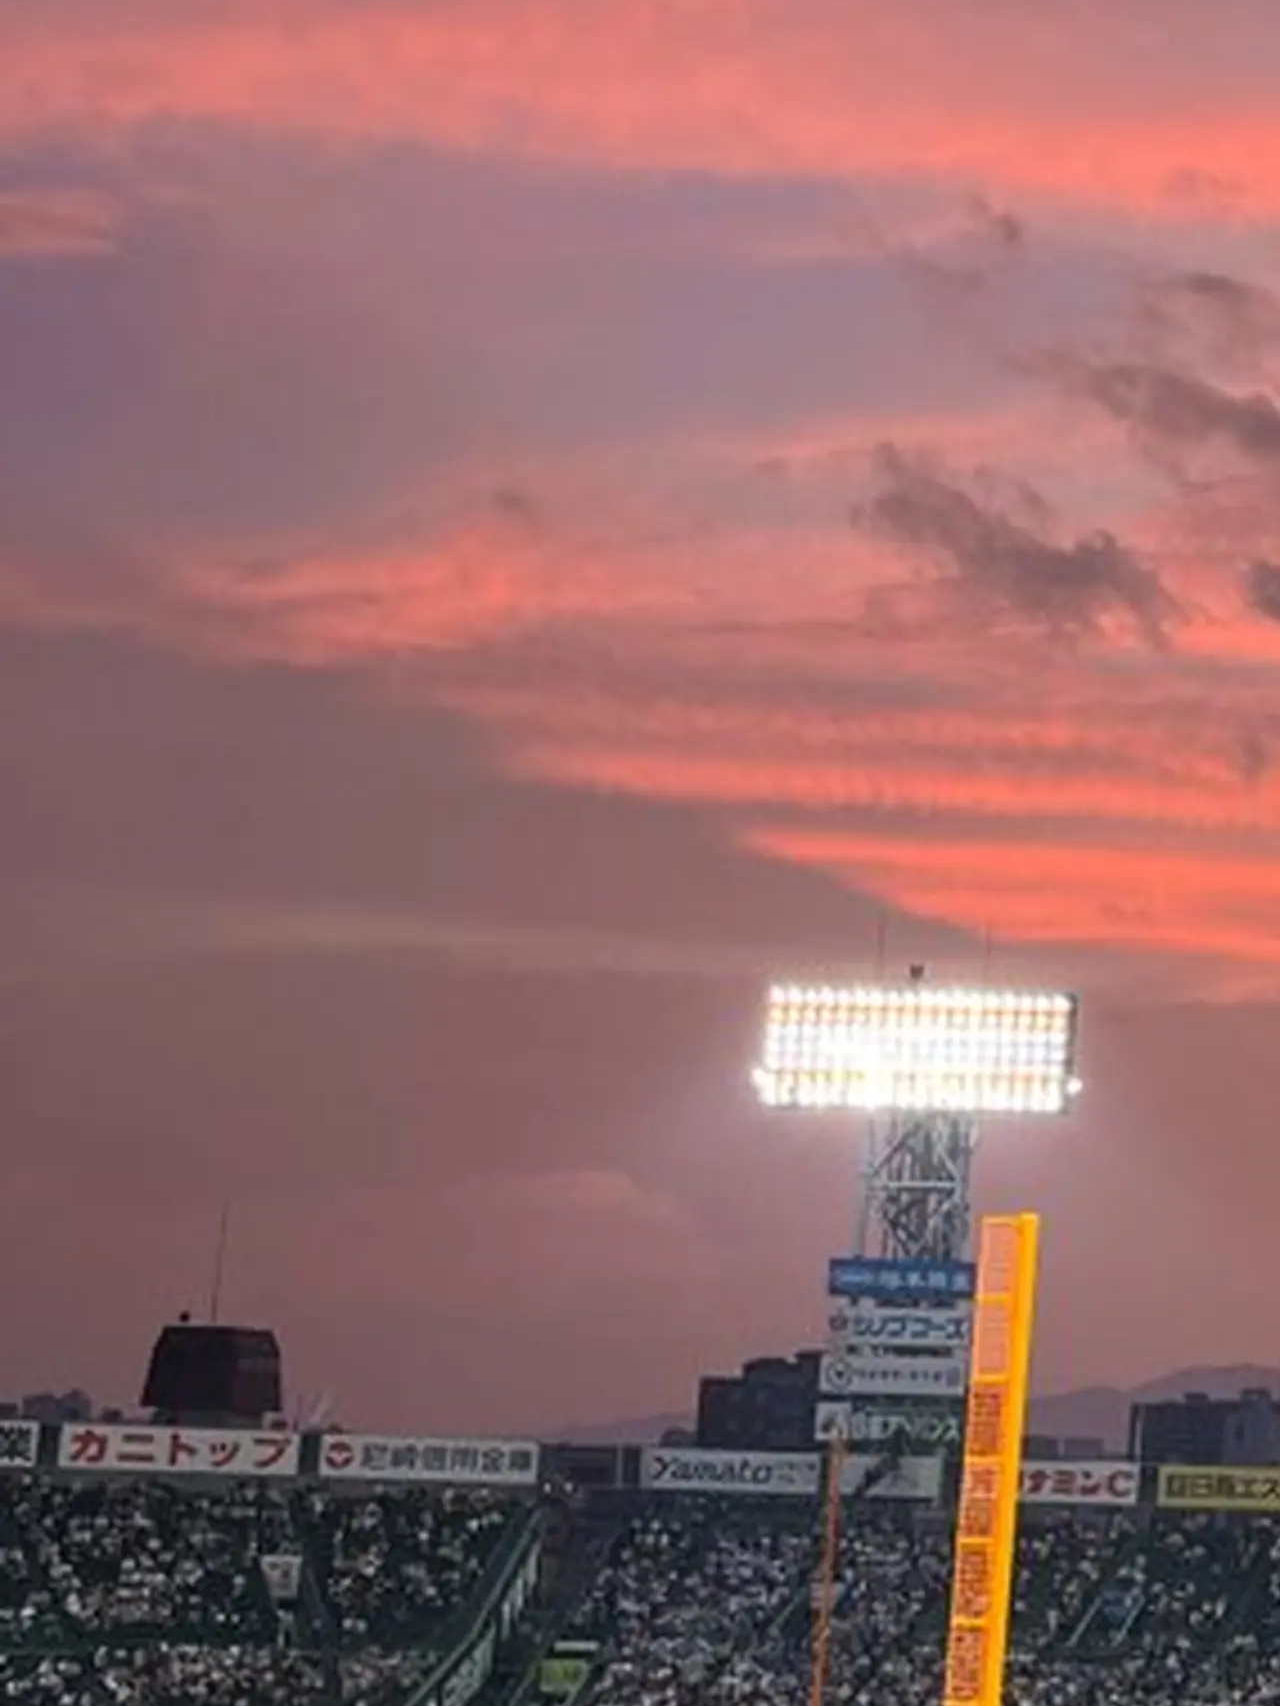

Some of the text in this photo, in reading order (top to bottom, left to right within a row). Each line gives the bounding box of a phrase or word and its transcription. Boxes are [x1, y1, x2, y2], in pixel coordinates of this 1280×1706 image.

[69, 1428, 292, 1468] カニトップ
